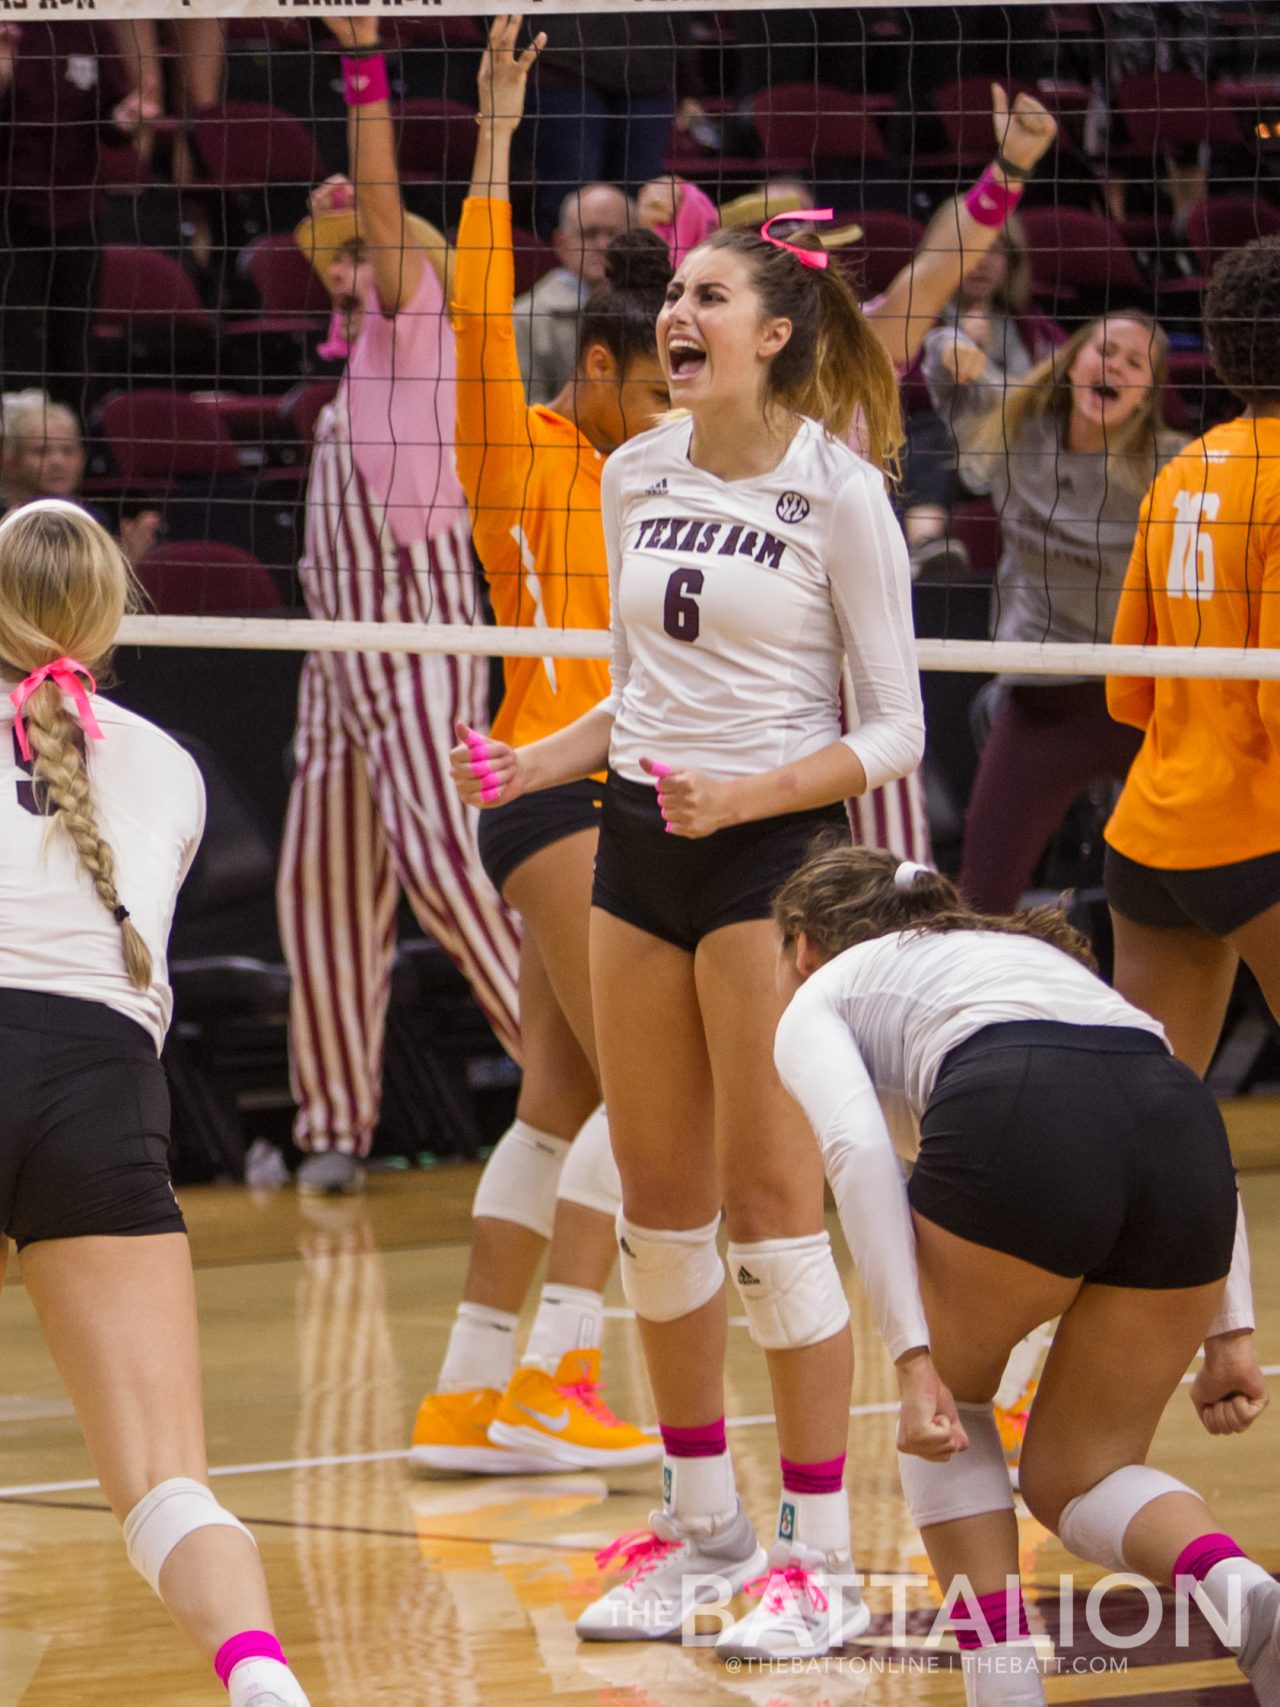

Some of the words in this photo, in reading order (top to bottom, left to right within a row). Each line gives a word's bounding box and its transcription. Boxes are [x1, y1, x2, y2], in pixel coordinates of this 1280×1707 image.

[633, 518, 722, 553] TEXAS
[718, 525, 786, 570] A&M
[1167, 490, 1220, 600] 16
[663, 567, 705, 643] 6
